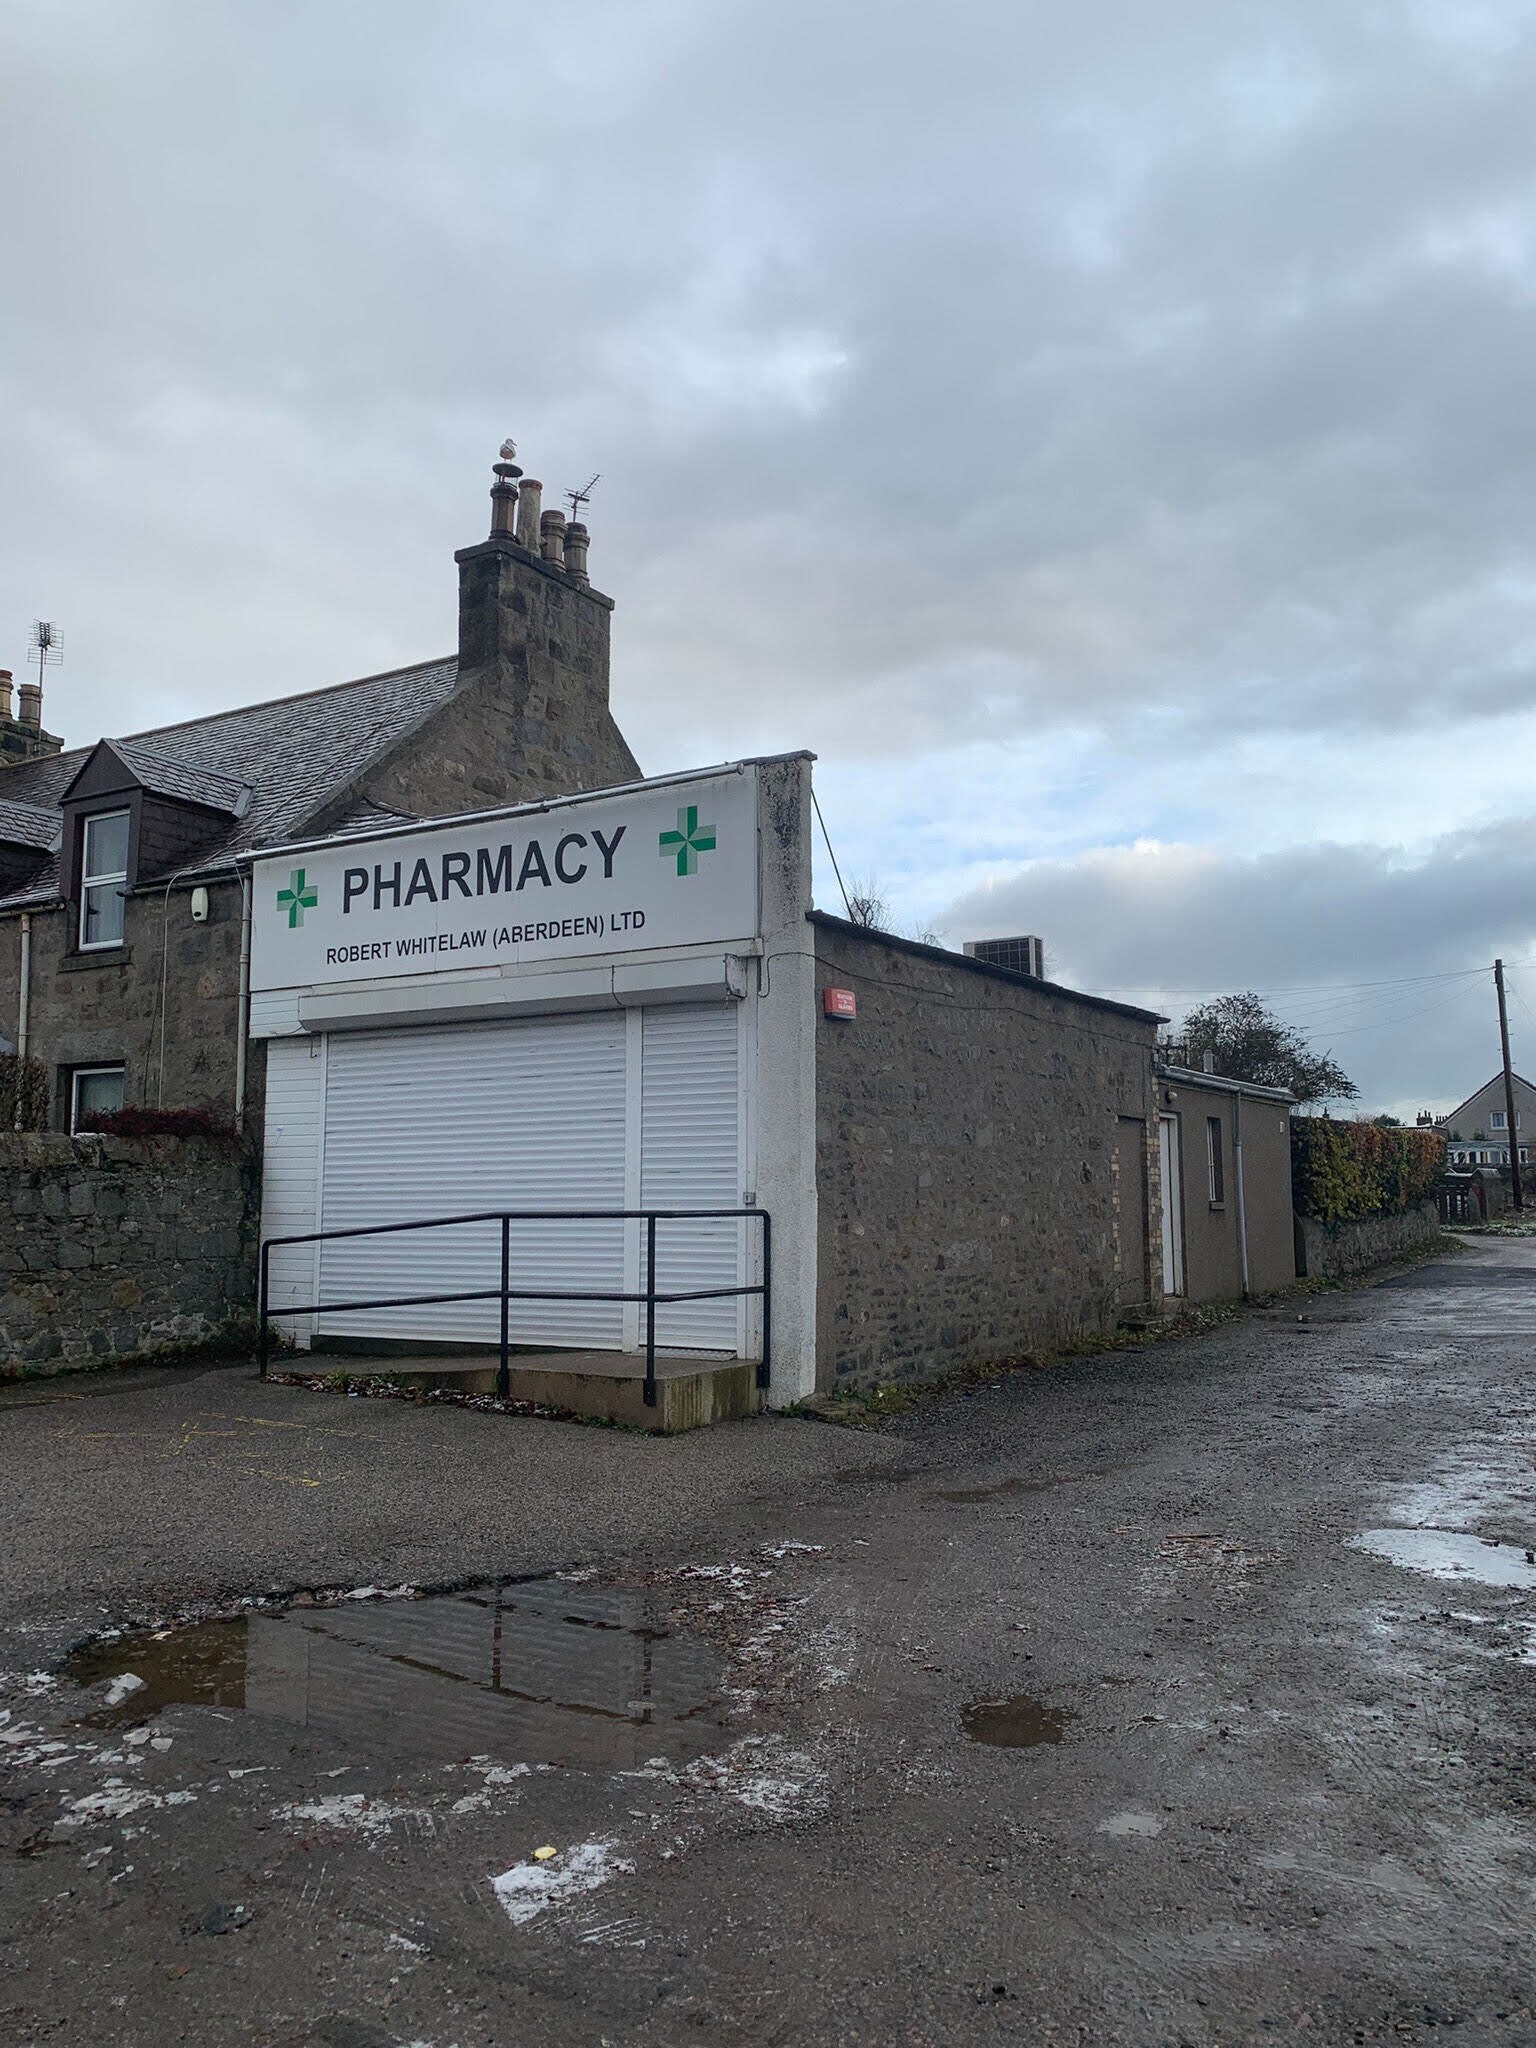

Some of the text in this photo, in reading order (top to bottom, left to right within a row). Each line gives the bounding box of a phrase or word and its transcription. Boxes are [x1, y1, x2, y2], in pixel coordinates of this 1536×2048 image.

[342, 825, 628, 914] PHARMACY
[326, 910, 646, 965] ROBERT WHITELAW (ABERDEEN) LTD
